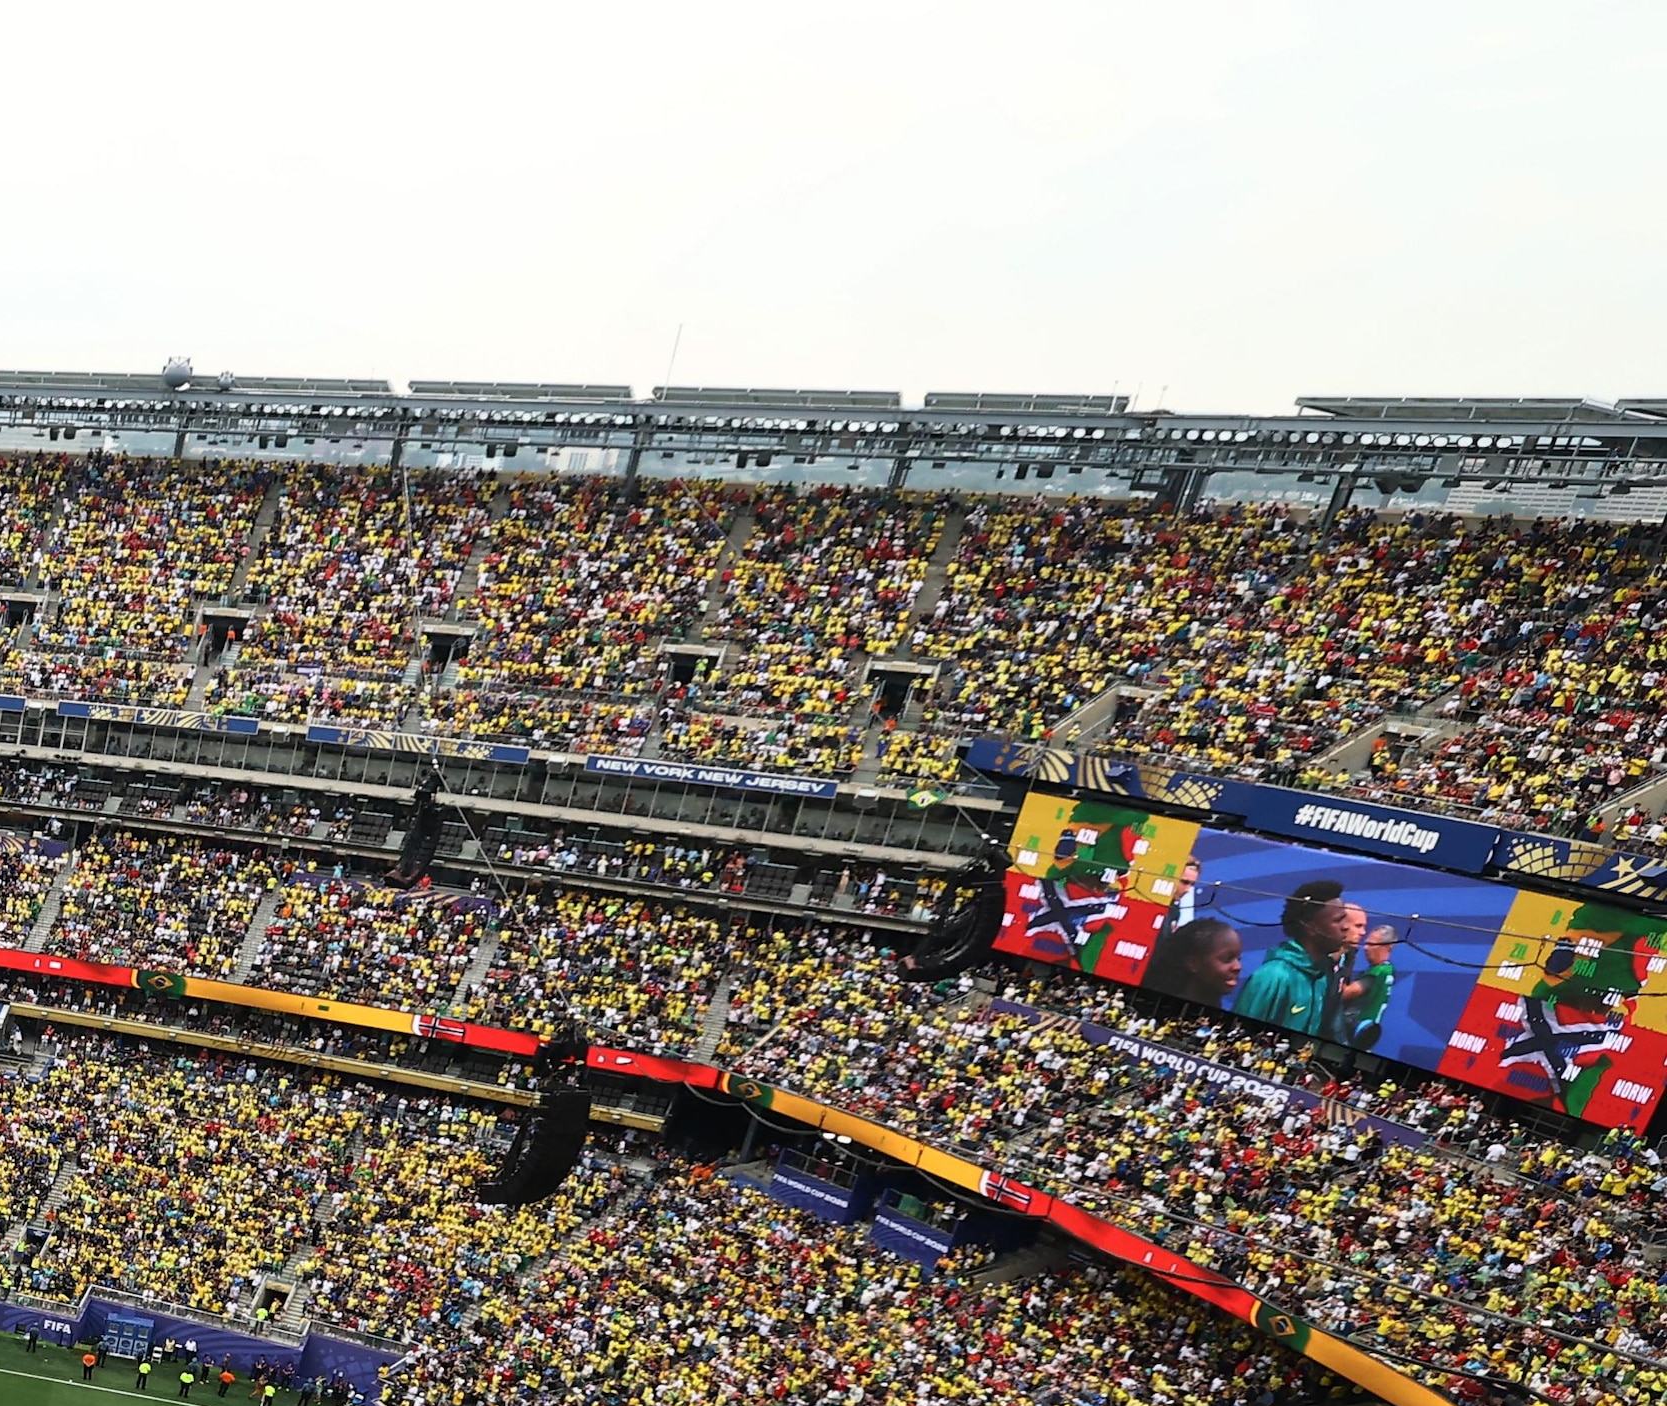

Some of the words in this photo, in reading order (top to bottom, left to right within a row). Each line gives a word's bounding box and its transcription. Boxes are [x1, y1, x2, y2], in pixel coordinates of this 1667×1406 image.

[595, 759, 641, 774] NEW
[642, 764, 694, 779] YORK
[697, 770, 744, 784] NEW
[744, 775, 825, 793] JERSEY
[1294, 804, 1440, 853] #FIFAWorldCup
[1496, 960, 1524, 981] BRA
[1495, 1002, 1522, 1022] NOR
[1448, 1030, 1487, 1054] NORW
[1603, 1032, 1633, 1053] WAY
[1108, 1036, 1140, 1057] FIFA
[1140, 1045, 1197, 1074] WORLD
[1196, 1064, 1231, 1084] CUP
[1230, 1076, 1291, 1102] 2026
[1611, 1078, 1654, 1105] NORW
[787, 1179, 811, 1194] WORLD
[810, 1187, 825, 1200] CUP
[888, 1220, 912, 1236] WORLD
[911, 1231, 926, 1243] CUP
[43, 1319, 71, 1334] FIFA
